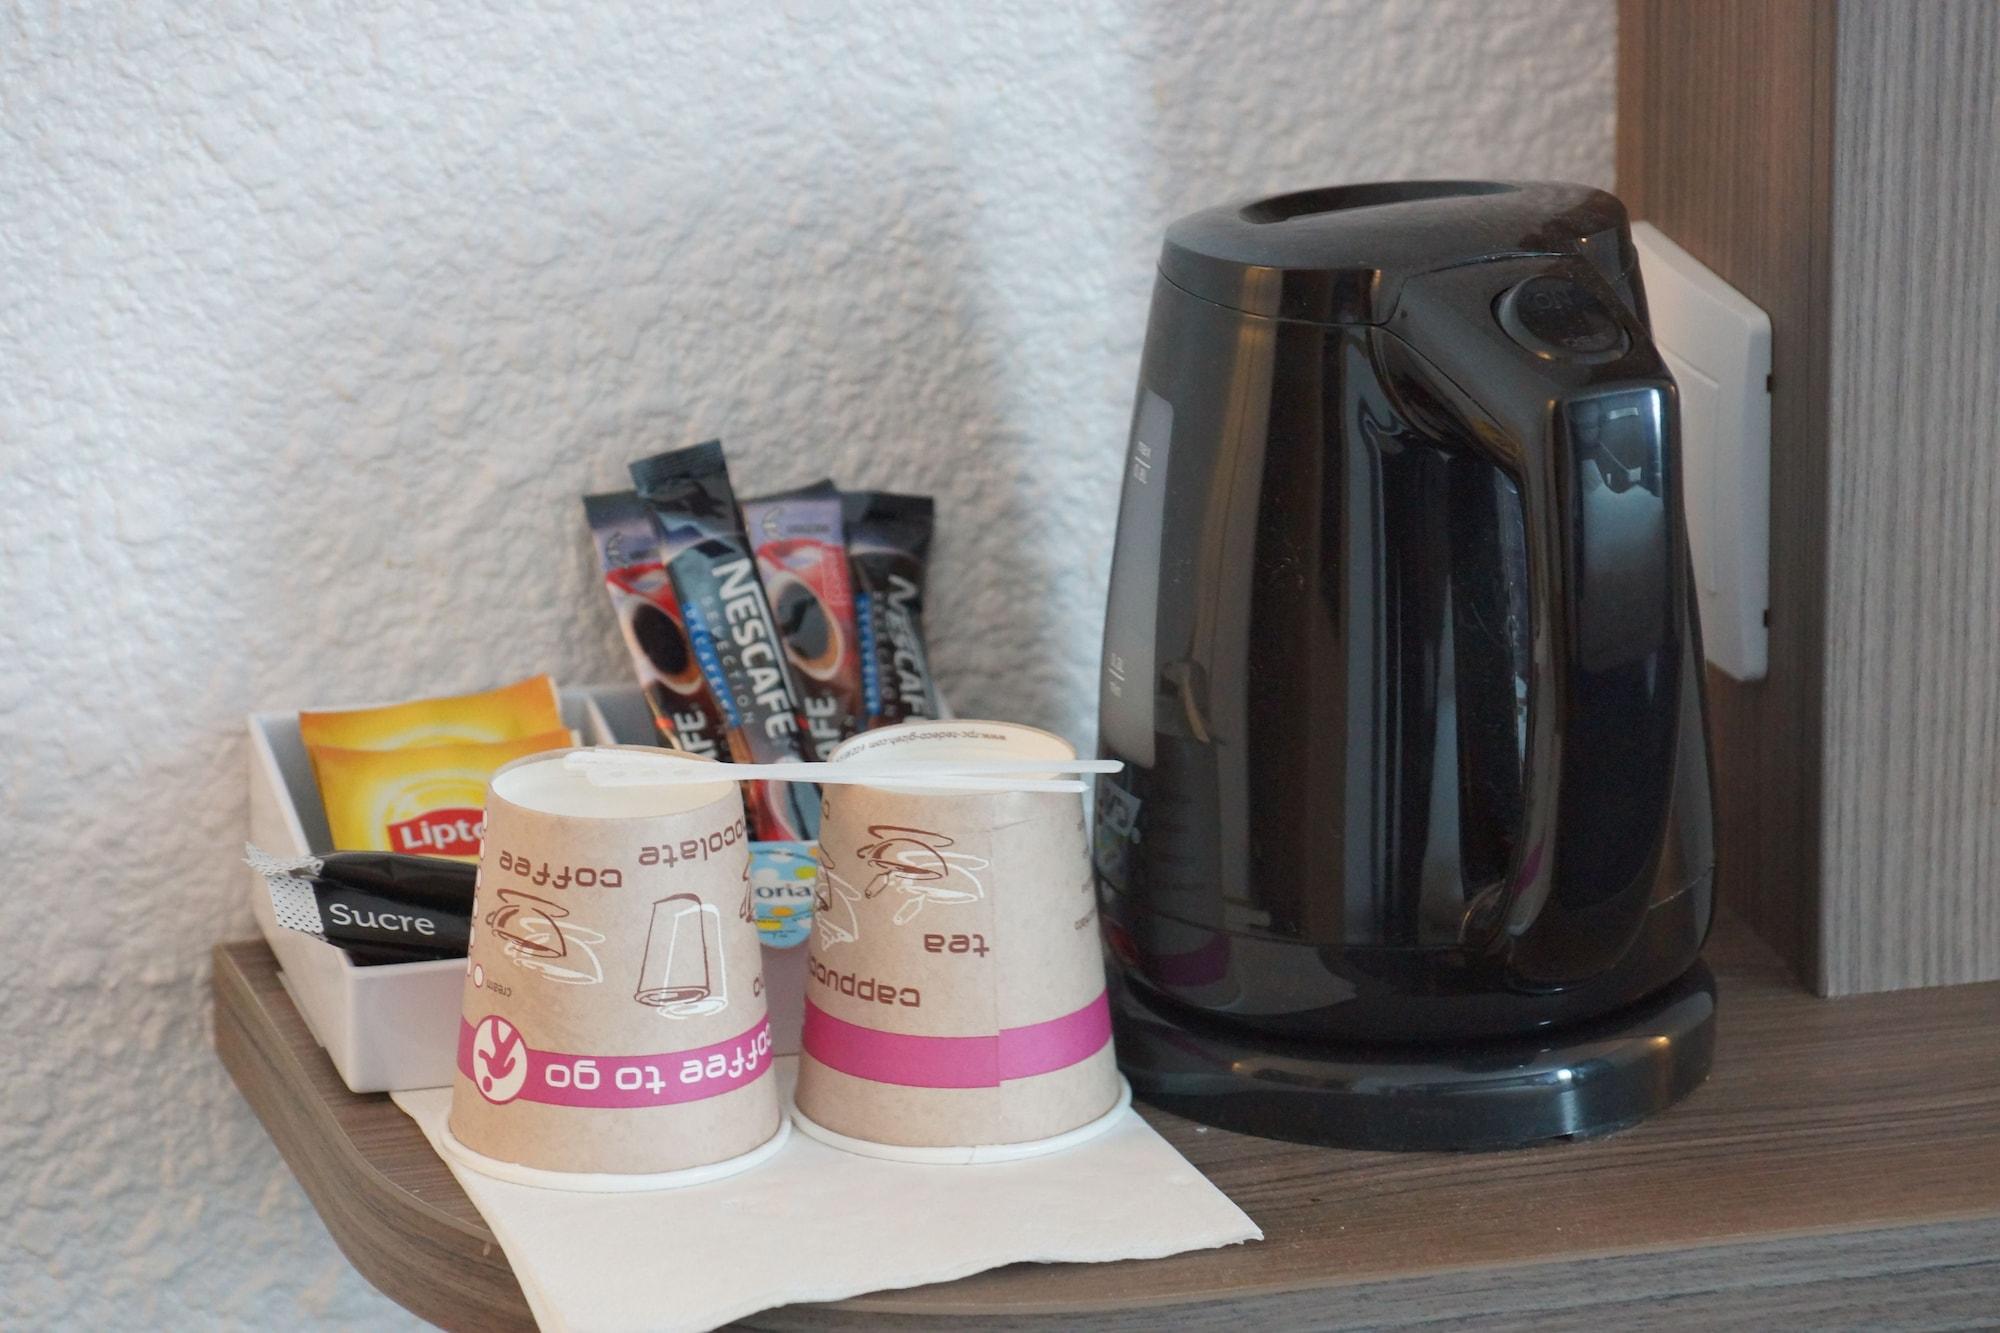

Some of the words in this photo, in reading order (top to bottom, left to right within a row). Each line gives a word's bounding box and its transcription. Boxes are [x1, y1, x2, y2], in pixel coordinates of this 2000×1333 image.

[886, 573, 928, 720] NESCAF
[400, 819, 483, 850] Lipto
[638, 817, 745, 867] ocolate
[499, 850, 622, 889] coffee
[756, 883, 811, 899] oria
[328, 903, 436, 936] Sucre
[924, 934, 989, 957] tea
[807, 956, 920, 1008] cappucc
[545, 1059, 600, 1090] go
[615, 1065, 666, 1094] to
